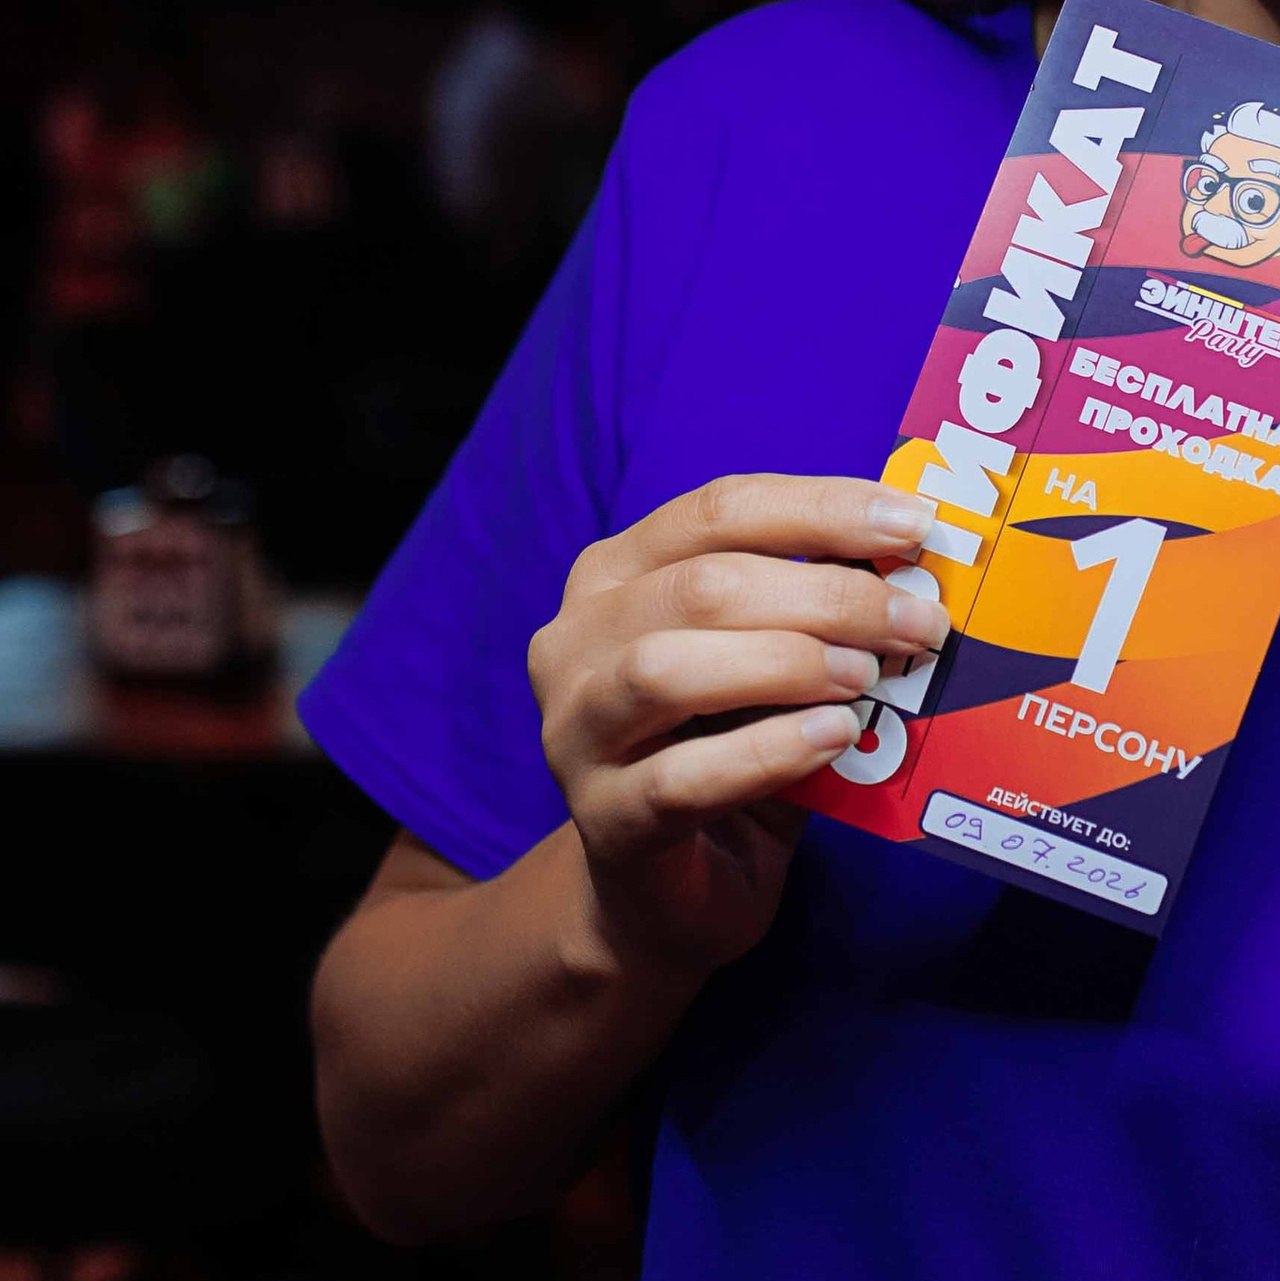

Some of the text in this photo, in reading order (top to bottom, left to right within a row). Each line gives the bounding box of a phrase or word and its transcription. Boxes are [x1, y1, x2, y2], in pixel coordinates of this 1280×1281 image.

[1184, 317, 1269, 368] Party
[1044, 468, 1098, 510] НА
[1071, 518, 1167, 694] 1
[1016, 693, 1202, 780] ПЕРСОНУ
[986, 786, 1131, 851] ДЕЙСТВУЕТ ДО:
